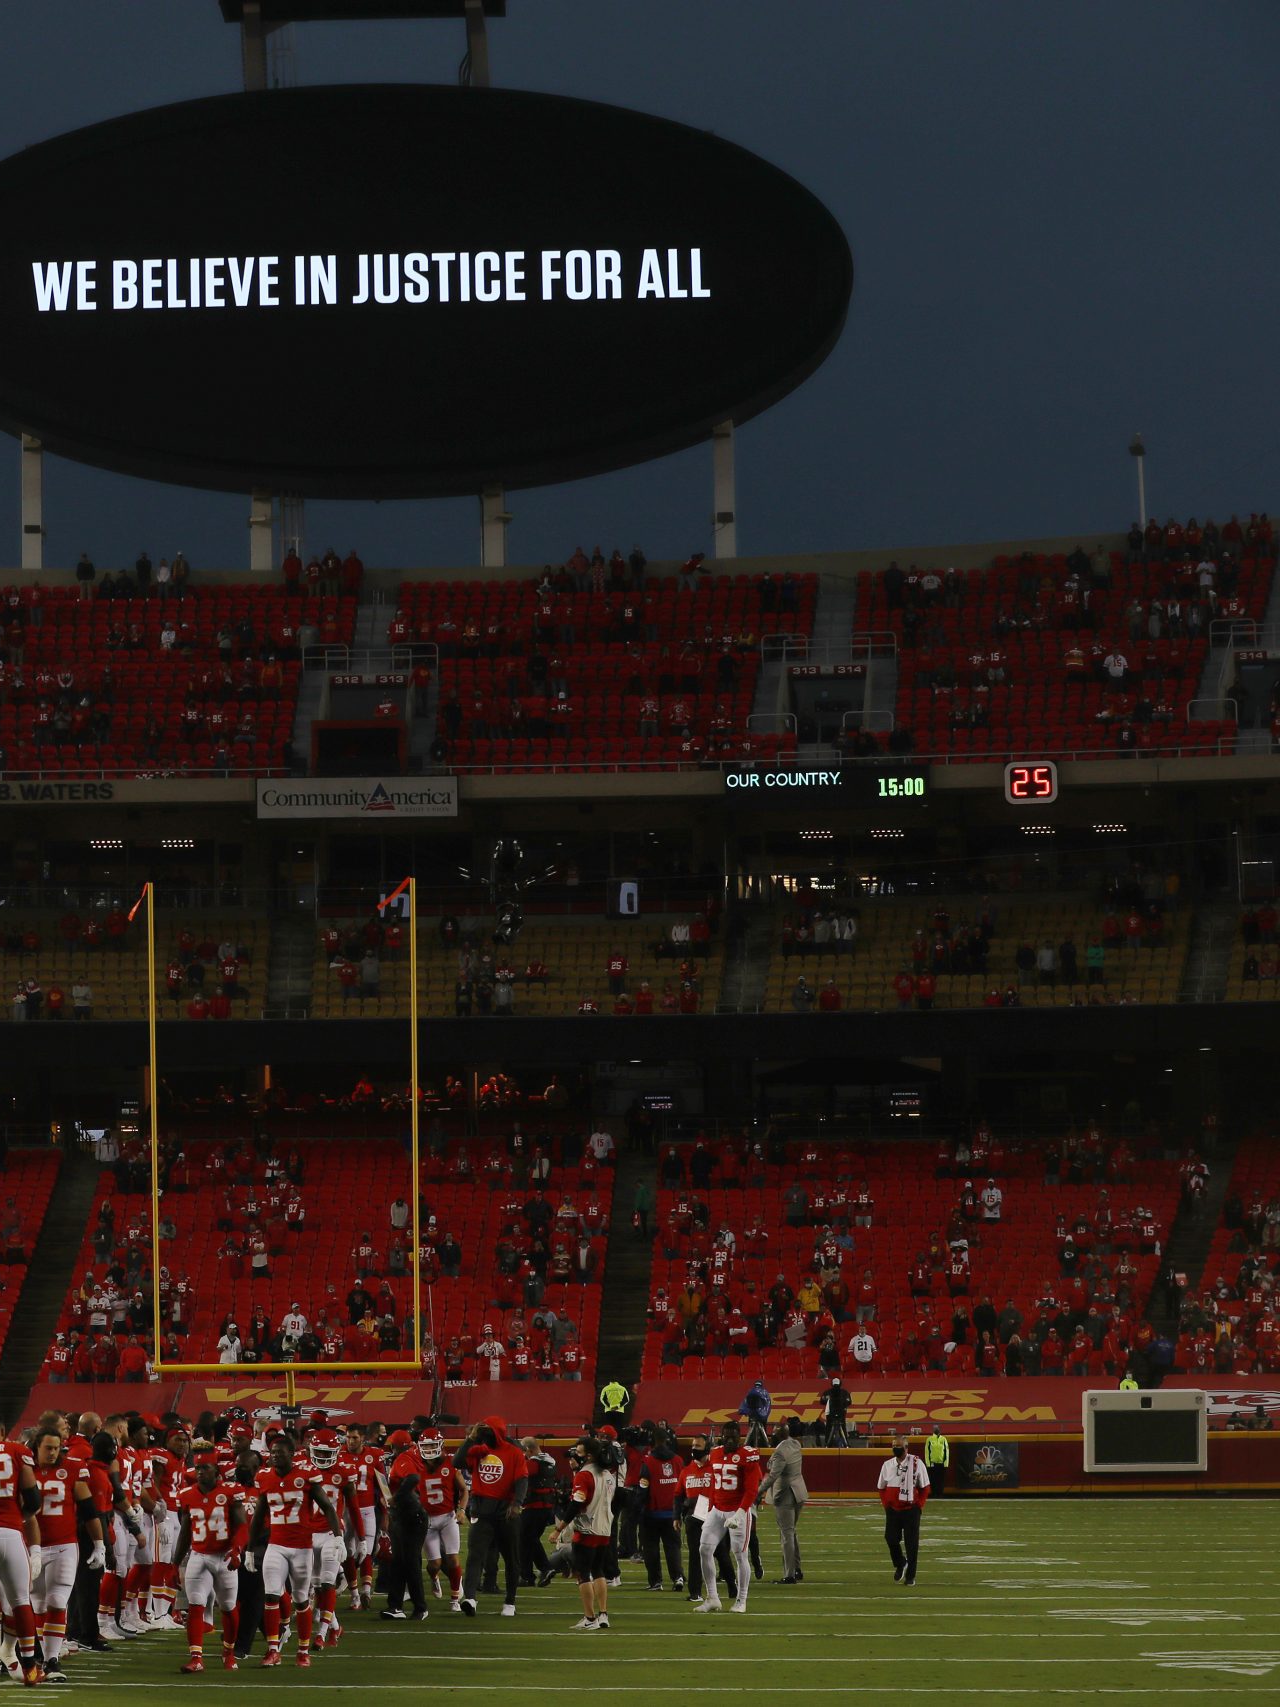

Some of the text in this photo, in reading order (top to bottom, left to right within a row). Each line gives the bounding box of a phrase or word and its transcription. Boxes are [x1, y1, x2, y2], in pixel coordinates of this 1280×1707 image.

[32, 248, 710, 311] WE BELIEVE IN JUSTICE FOR ALL
[1229, 602, 1238, 611] 15
[395, 624, 404, 633] 15
[990, 653, 1000, 662] 15
[1239, 652, 1264, 661] 314
[792, 666, 817, 675] 313
[838, 665, 862, 674] 314
[335, 676, 359, 685] 312
[380, 675, 404, 684] 313
[39, 713, 48, 721] 15
[727, 772, 841, 787] OUR COUNTRY.
[1011, 767, 1051, 797] 25
[20, 783, 113, 800] WATERS
[879, 778, 923, 796] 15:00
[611, 961, 622, 971] 25
[582, 1002, 593, 1011] 15
[248, 1203, 256, 1211] 15
[288, 1204, 297, 1213] 87
[588, 1207, 597, 1216] 15
[678, 1204, 687, 1212] 15
[1143, 1225, 1154, 1235] 15
[826, 1247, 837, 1256] 32
[951, 1264, 963, 1274] 87
[713, 1275, 724, 1284] 15
[655, 1302, 667, 1311] 58
[290, 1320, 300, 1330] 91
[857, 1341, 867, 1350] 21
[54, 1352, 66, 1361] 50
[516, 1355, 527, 1364] 32
[565, 1352, 576, 1361] 35
[205, 1387, 413, 1402] VOTE
[478, 1464, 503, 1473] VOTE
[974, 1463, 1005, 1474] NBC
[712, 1463, 738, 1491] 55
[968, 1471, 1009, 1483] Sports
[685, 1477, 711, 1489] CHIEFS
[425, 1478, 444, 1505] 5
[267, 1491, 304, 1525] 27
[189, 1508, 228, 1542] 34
